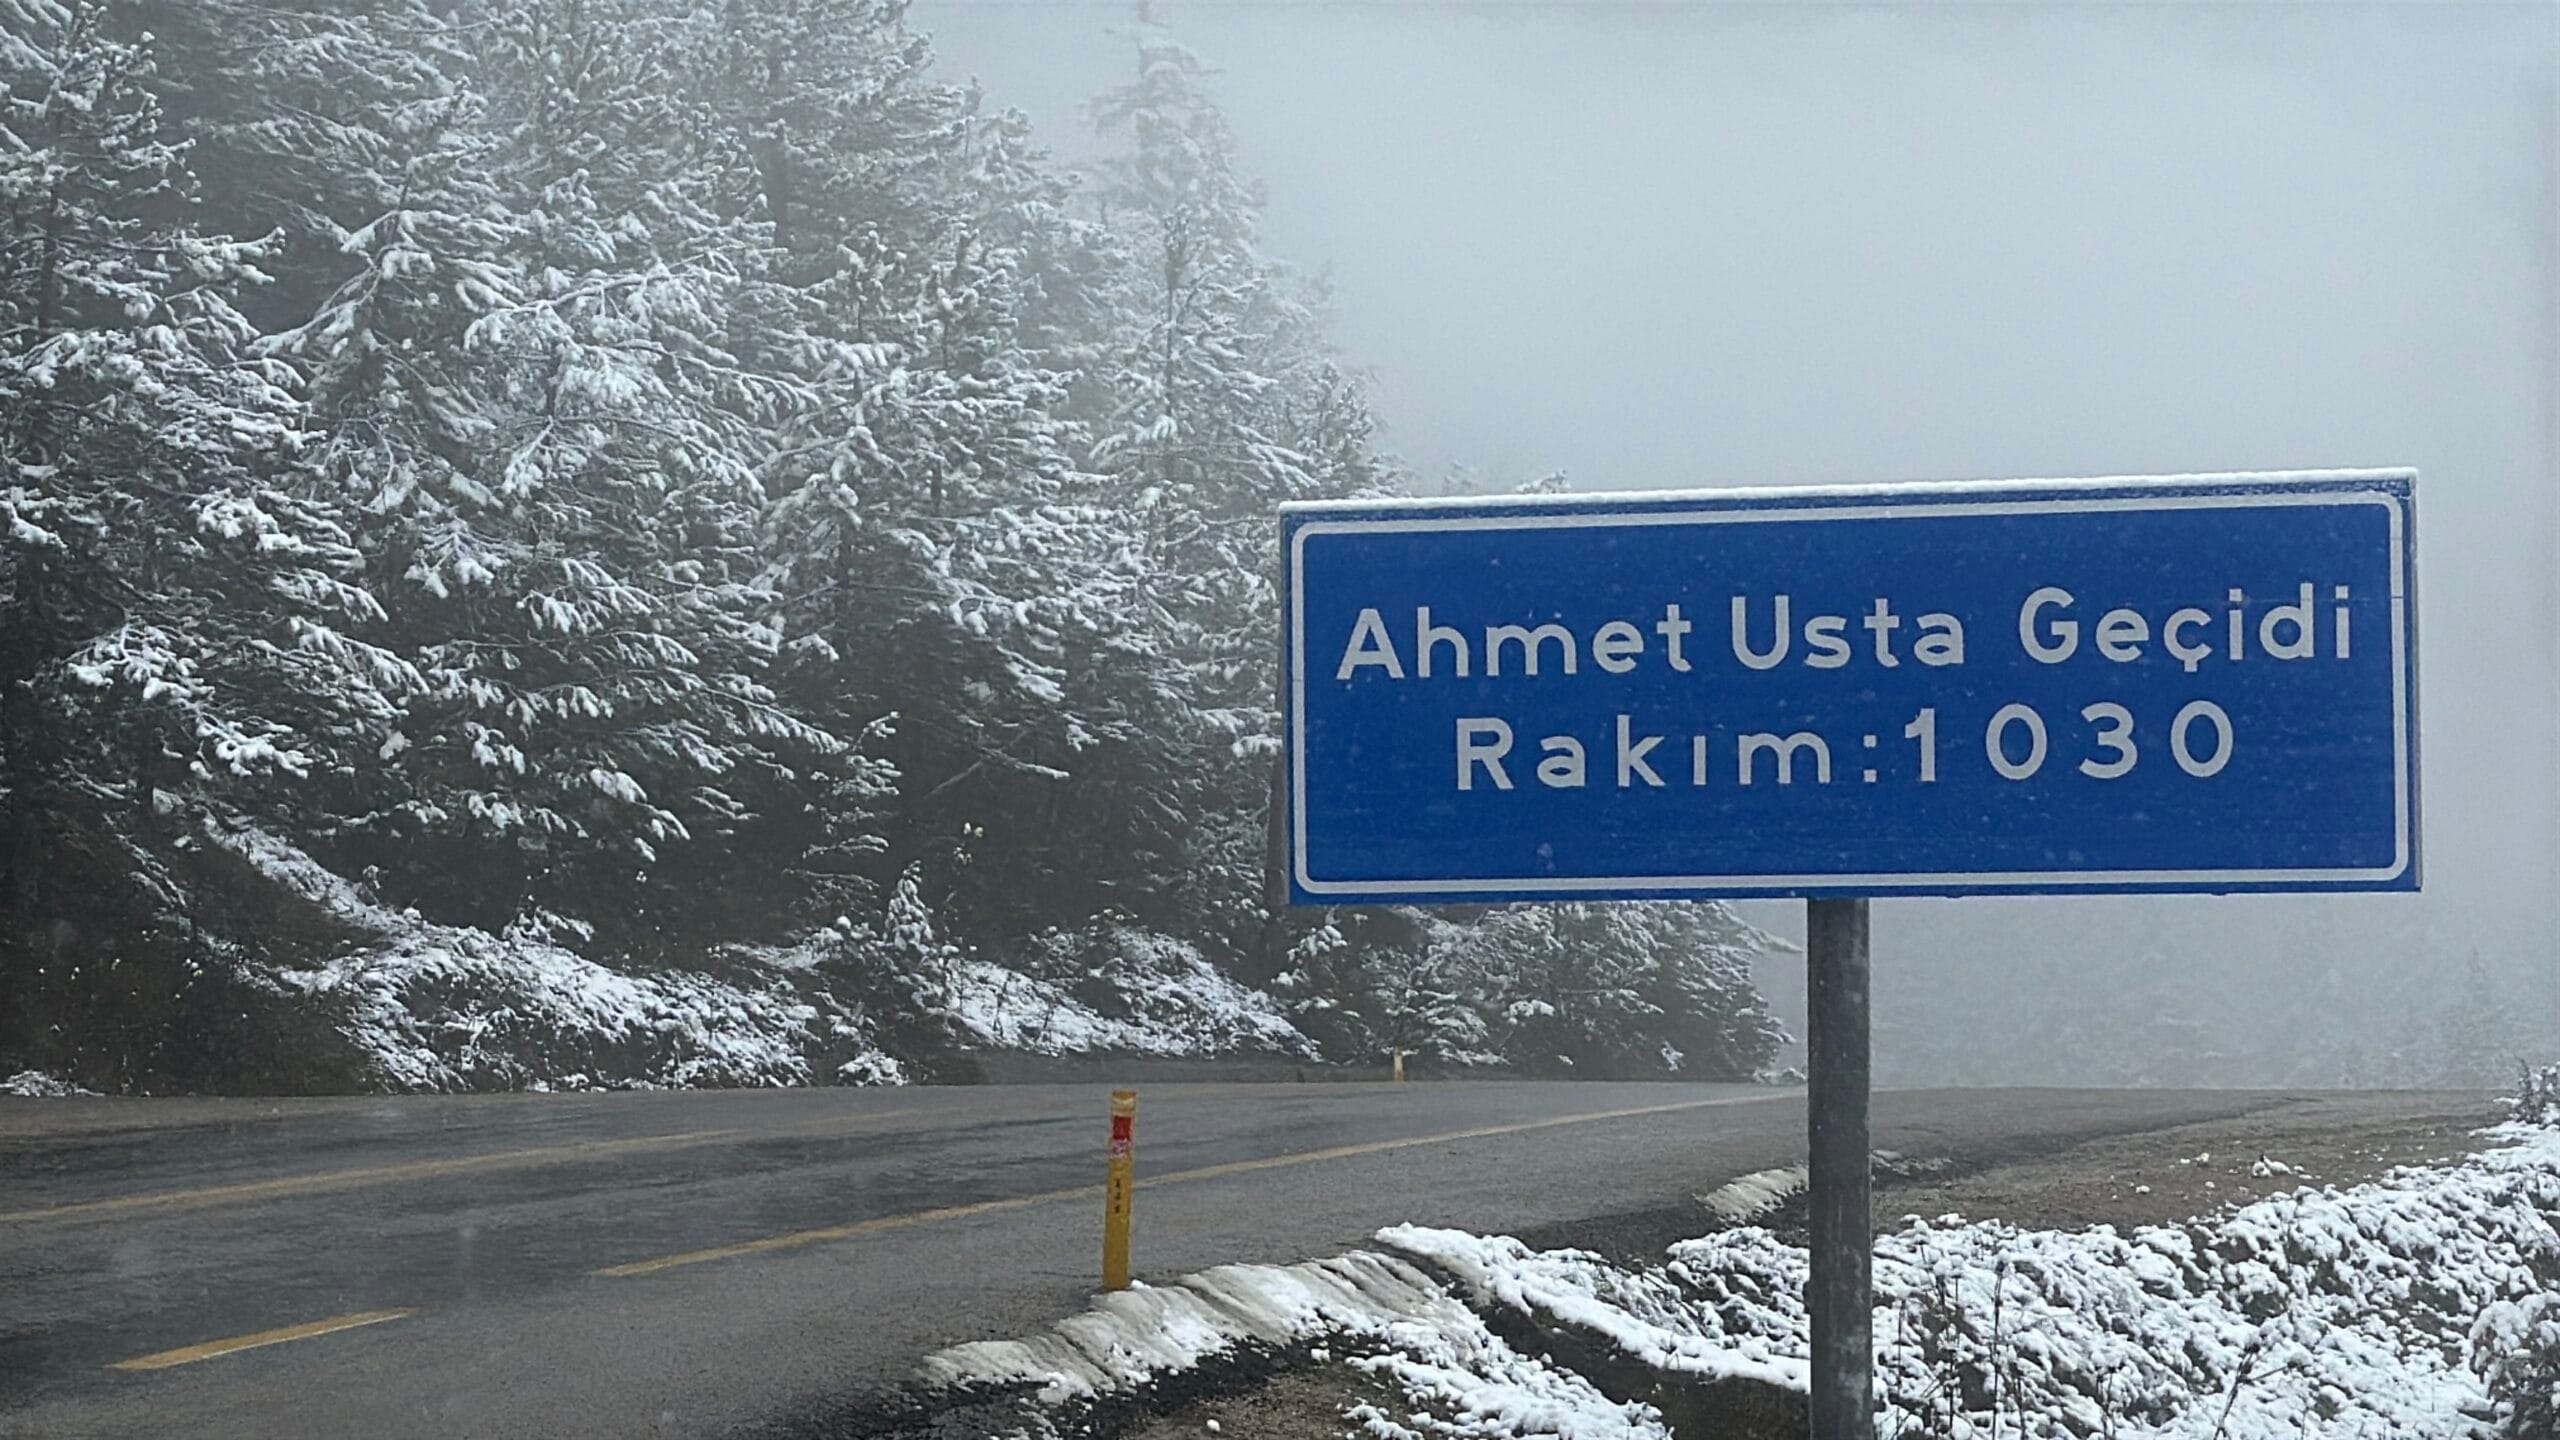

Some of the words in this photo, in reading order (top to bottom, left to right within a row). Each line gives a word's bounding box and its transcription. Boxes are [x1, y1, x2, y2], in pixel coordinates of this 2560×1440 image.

[1338, 597, 1691, 679] Ahmet
[1733, 596, 1965, 670] Usta
[2020, 583, 2350, 672] Geçidi
